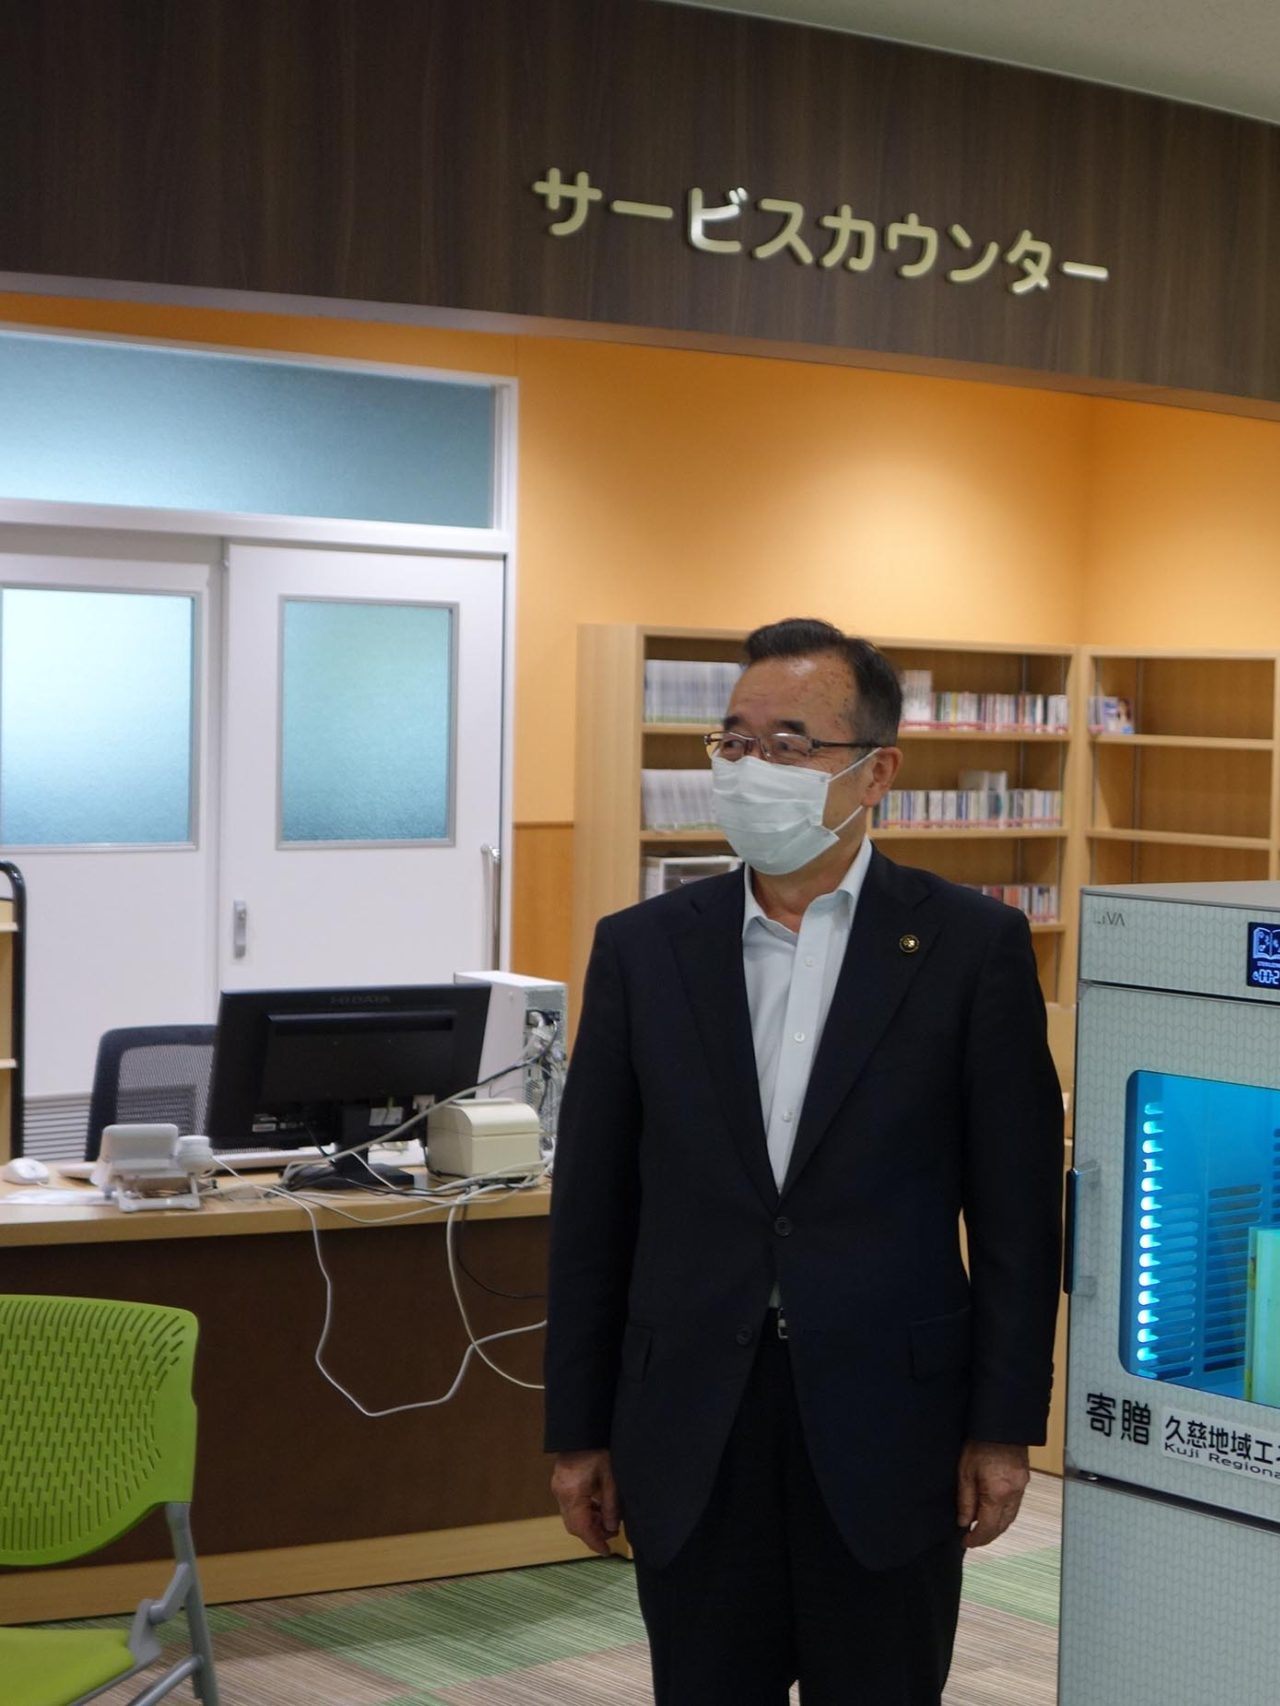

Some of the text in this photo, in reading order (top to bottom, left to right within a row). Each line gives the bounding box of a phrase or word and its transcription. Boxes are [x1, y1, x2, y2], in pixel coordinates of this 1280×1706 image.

[532, 167, 1109, 294] サービスカウンター
[1086, 1392, 1151, 1446] 寄贈
[1164, 1442, 1199, 1458] Kuji
